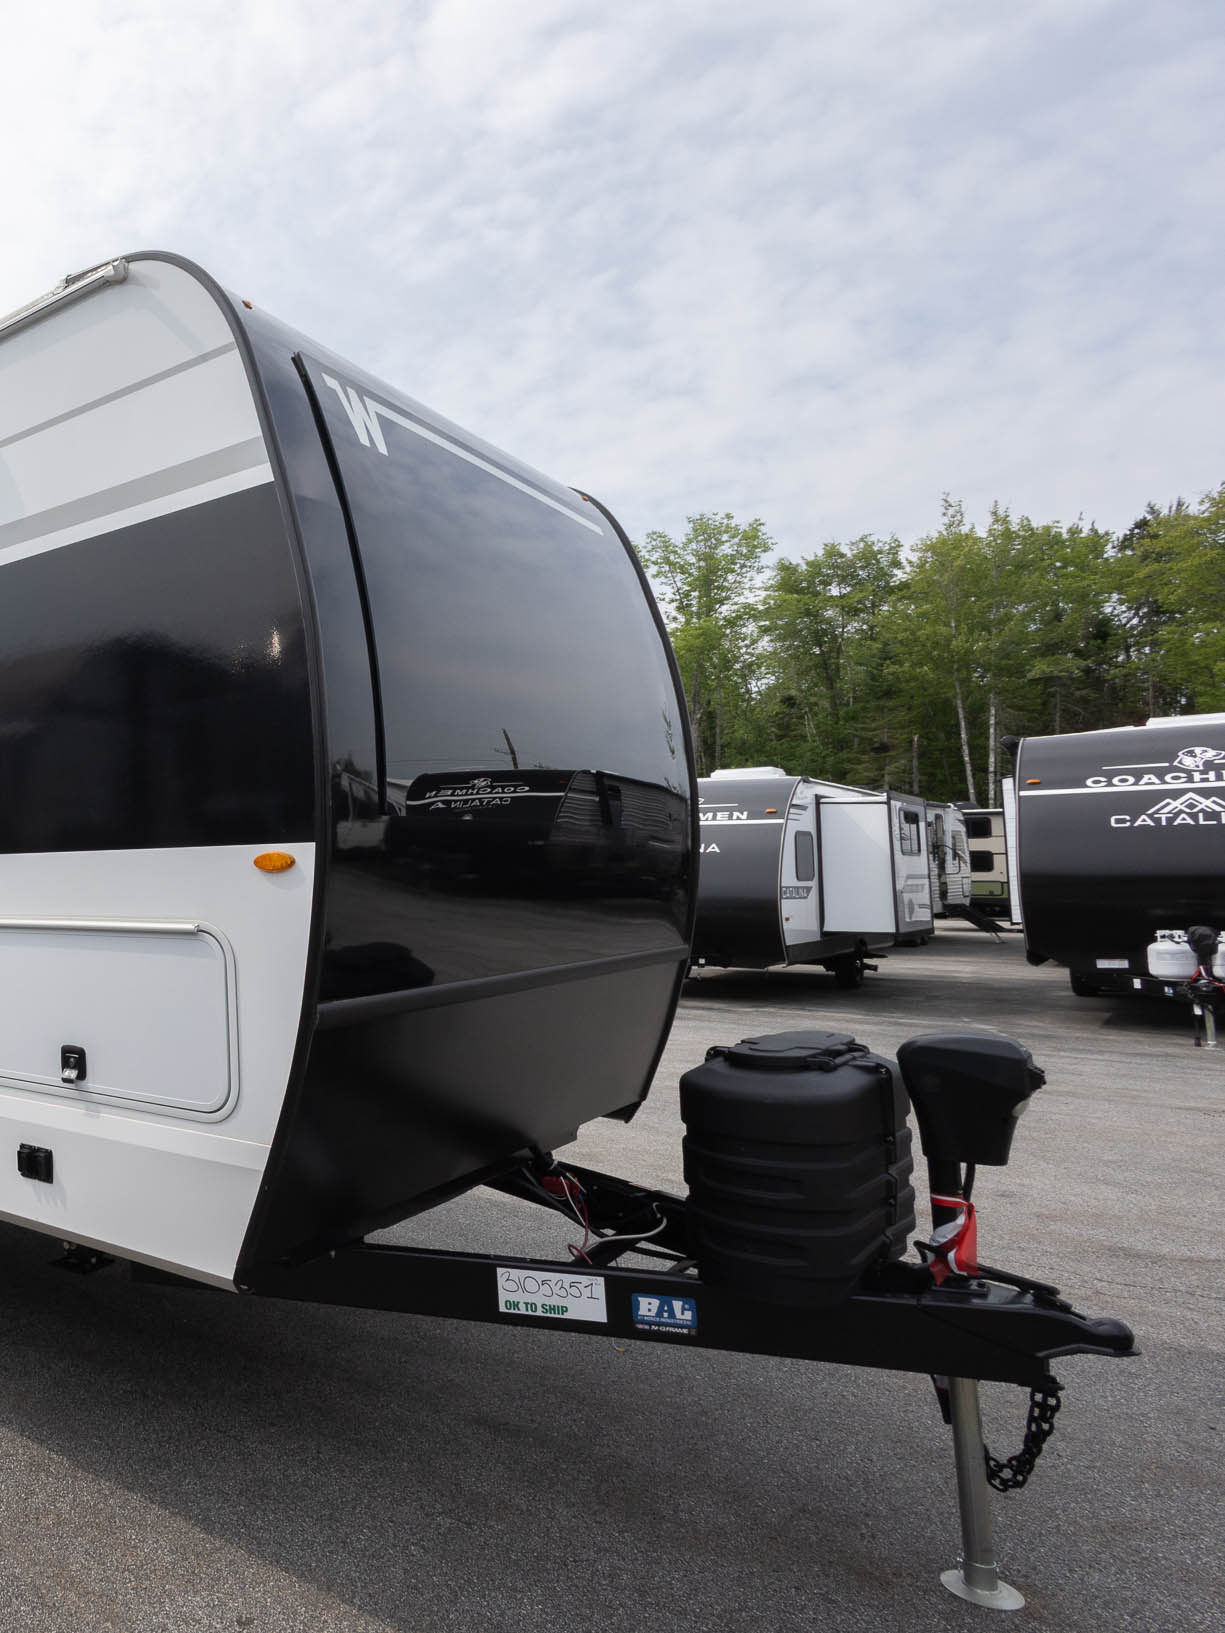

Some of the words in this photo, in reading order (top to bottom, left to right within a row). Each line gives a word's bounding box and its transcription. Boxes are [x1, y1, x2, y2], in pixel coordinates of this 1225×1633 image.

[1085, 770, 1225, 787] COACH
[500, 1271, 600, 1300] 3105351
[504, 1299, 521, 1312] OK
[523, 1301, 538, 1314] TO
[541, 1303, 569, 1316] SHIP
[637, 1296, 693, 1321] BAL
